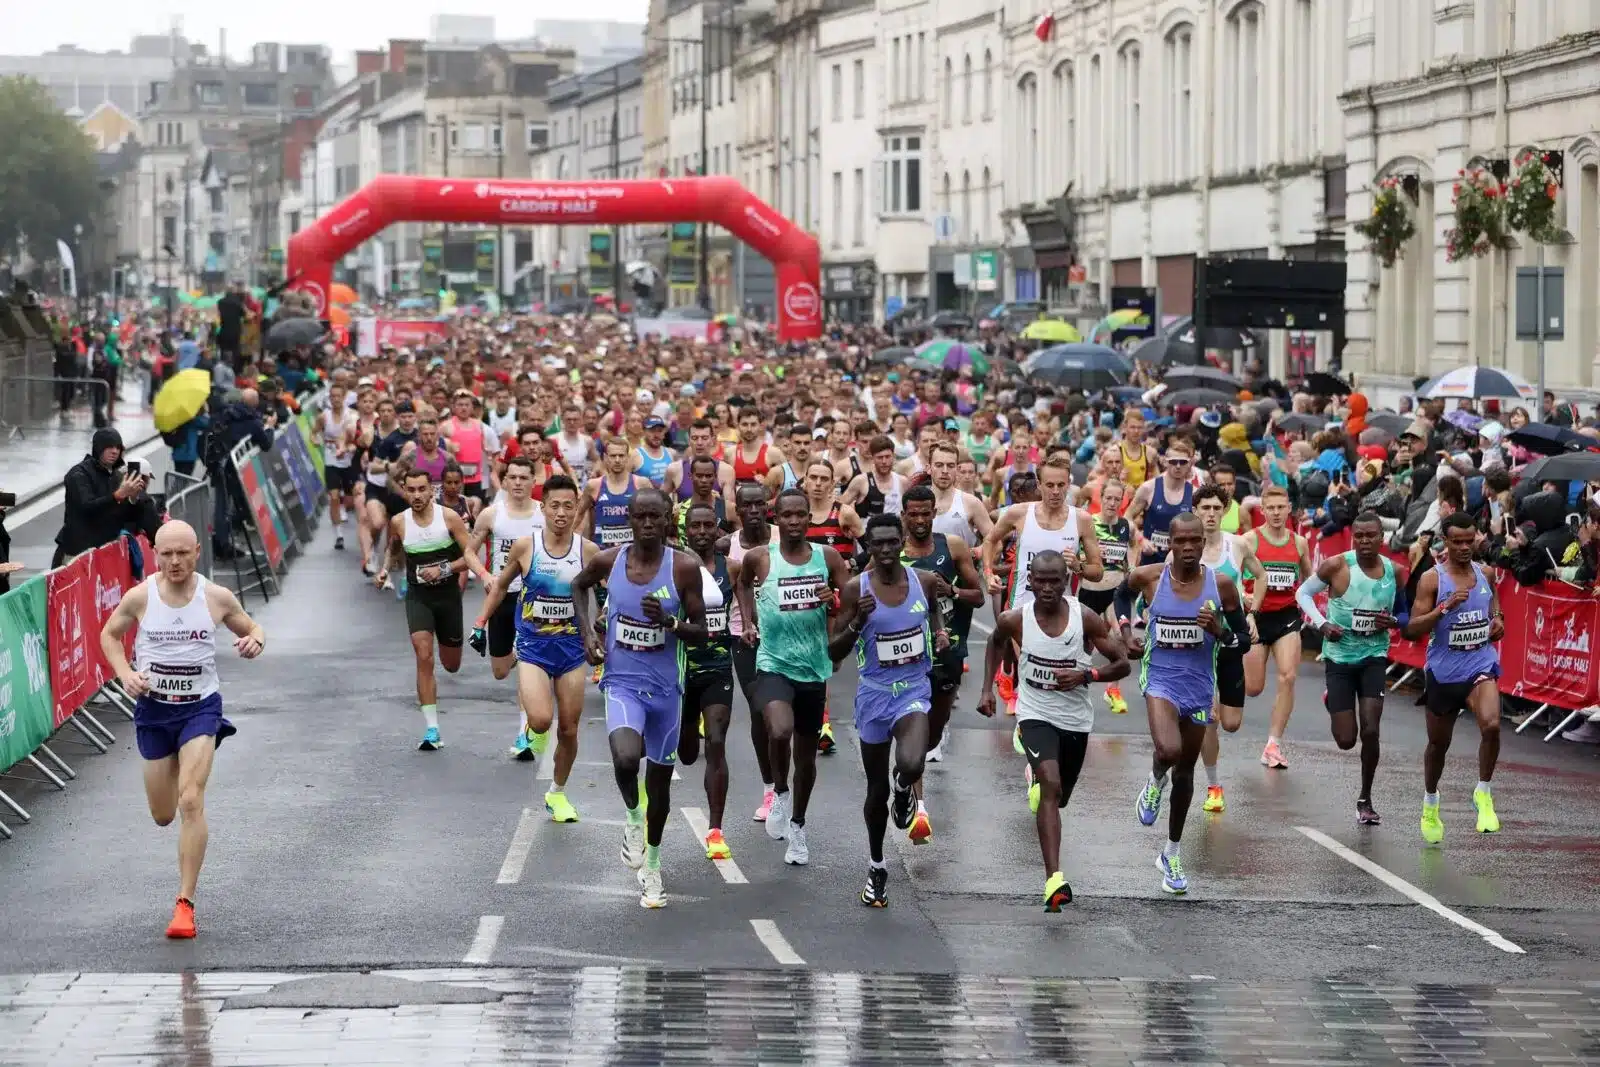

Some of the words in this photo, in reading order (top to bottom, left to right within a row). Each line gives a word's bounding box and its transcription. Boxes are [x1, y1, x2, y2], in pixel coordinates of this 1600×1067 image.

[501, 200, 557, 212] CARDIFF
[562, 200, 597, 212] HALF
[602, 505, 630, 516] FRANC
[1270, 575, 1291, 583] LEWIS
[542, 605, 568, 615] NISHI
[190, 630, 208, 640] AC
[623, 629, 649, 642] PACE
[652, 633, 657, 642] 1
[1160, 629, 1198, 639] KIMTAI
[1452, 631, 1486, 642] JAMAAL
[893, 642, 913, 655] BOI
[157, 679, 193, 690] JAMES
